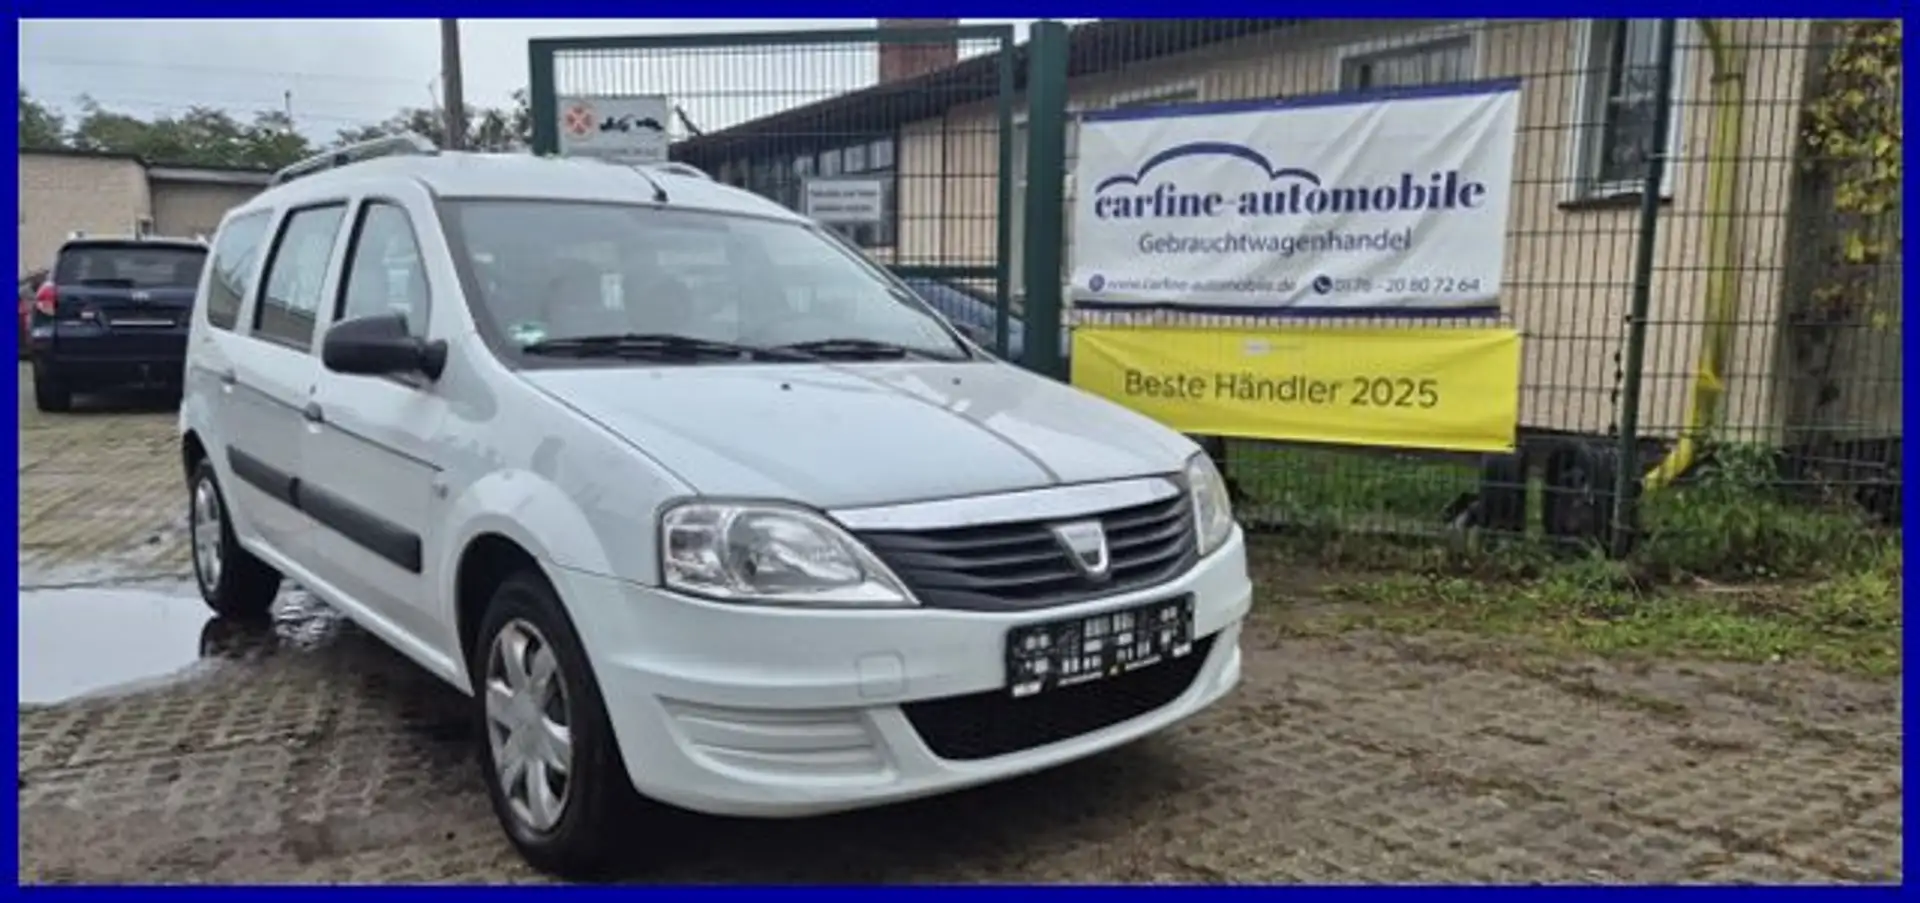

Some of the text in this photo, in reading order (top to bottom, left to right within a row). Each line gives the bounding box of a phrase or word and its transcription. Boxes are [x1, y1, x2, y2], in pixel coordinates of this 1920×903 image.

[1094, 170, 1486, 220] carfine-automobile
[1138, 228, 1413, 257] Gebrauchtwagenhandel
[1385, 277, 1406, 292] 20
[1409, 277, 1431, 292] 80
[1434, 277, 1454, 292] 72
[1458, 277, 1482, 292] 64
[1124, 369, 1439, 409] Beste Händler 2025
